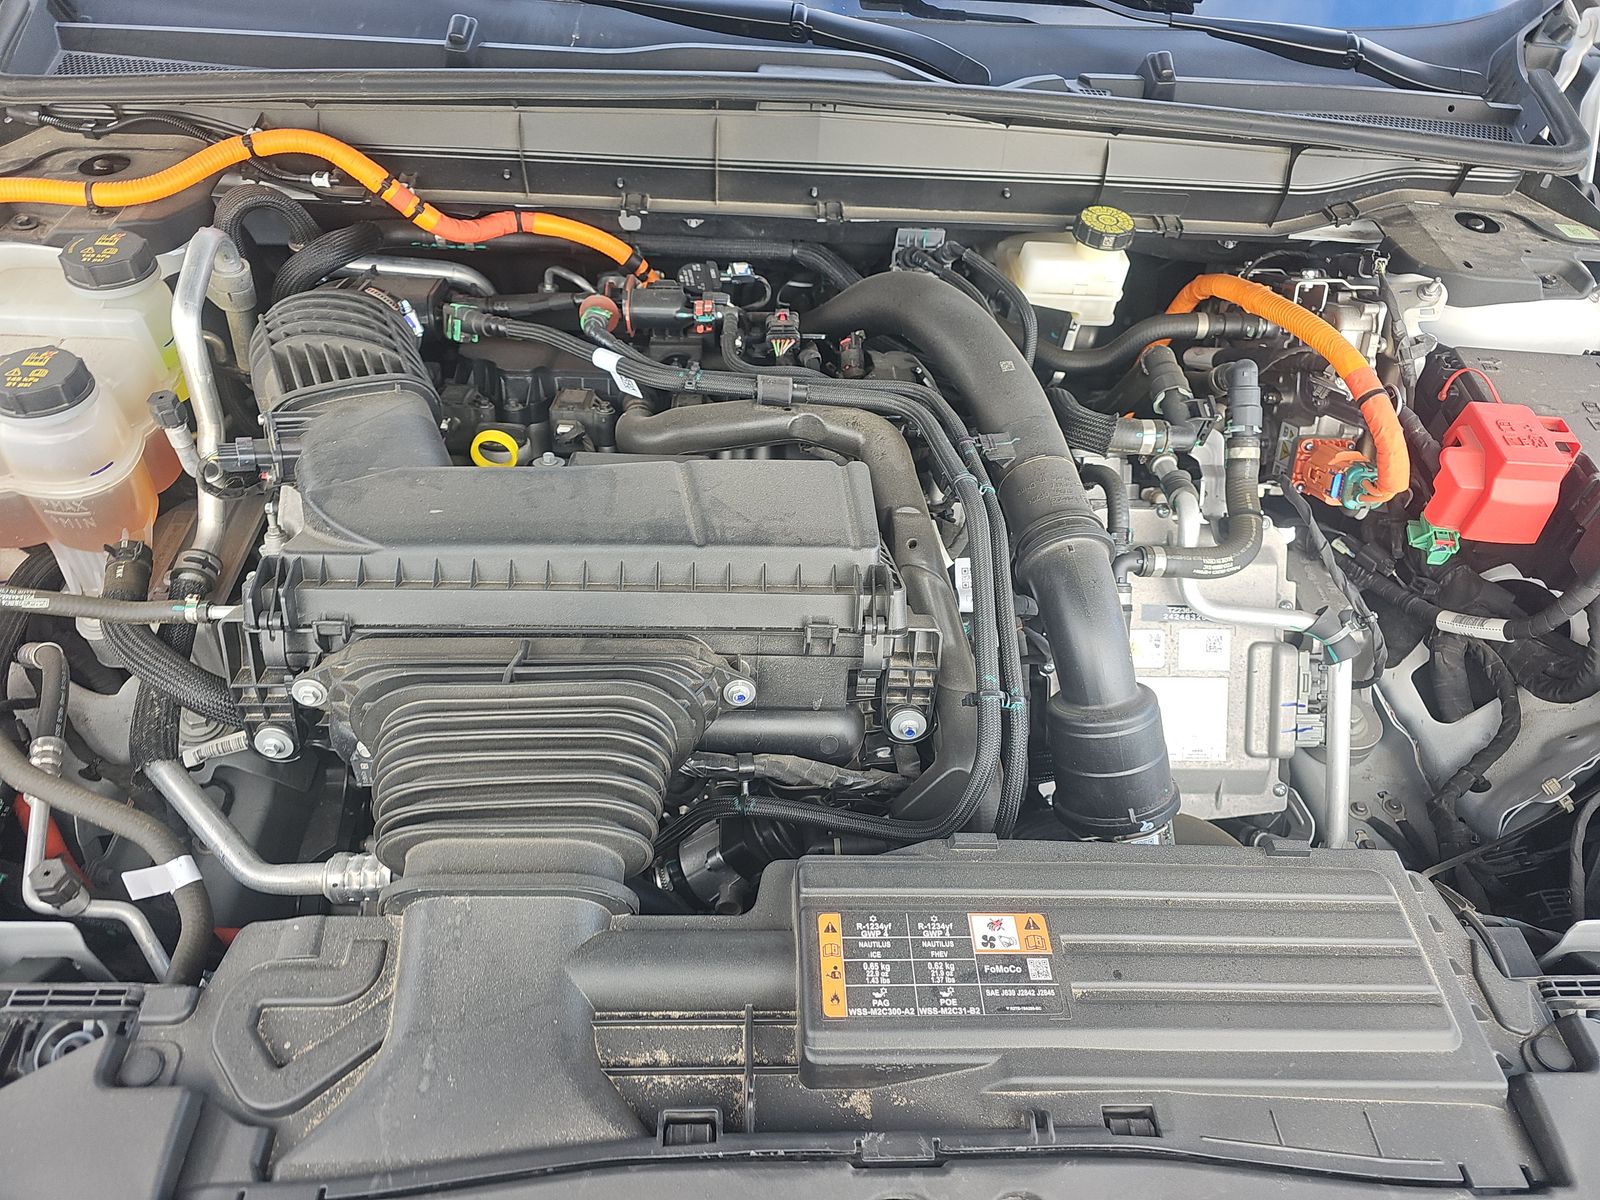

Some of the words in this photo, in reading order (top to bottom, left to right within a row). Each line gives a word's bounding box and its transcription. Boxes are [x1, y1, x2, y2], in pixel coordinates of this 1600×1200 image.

[856, 922, 892, 931] R-1234yf
[917, 922, 953, 931] R-1234yf
[862, 962, 880, 970] 0.65
[880, 962, 891, 972] kg
[927, 962, 944, 970] 0.62
[944, 962, 955, 972] kg
[984, 964, 1023, 973] FoMoCo
[872, 999, 890, 1007] PAG
[940, 998, 958, 1006] POE
[848, 1008, 915, 1016] WSS-M2C300-A2
[920, 1007, 981, 1015] WSS-M2C31-B2
